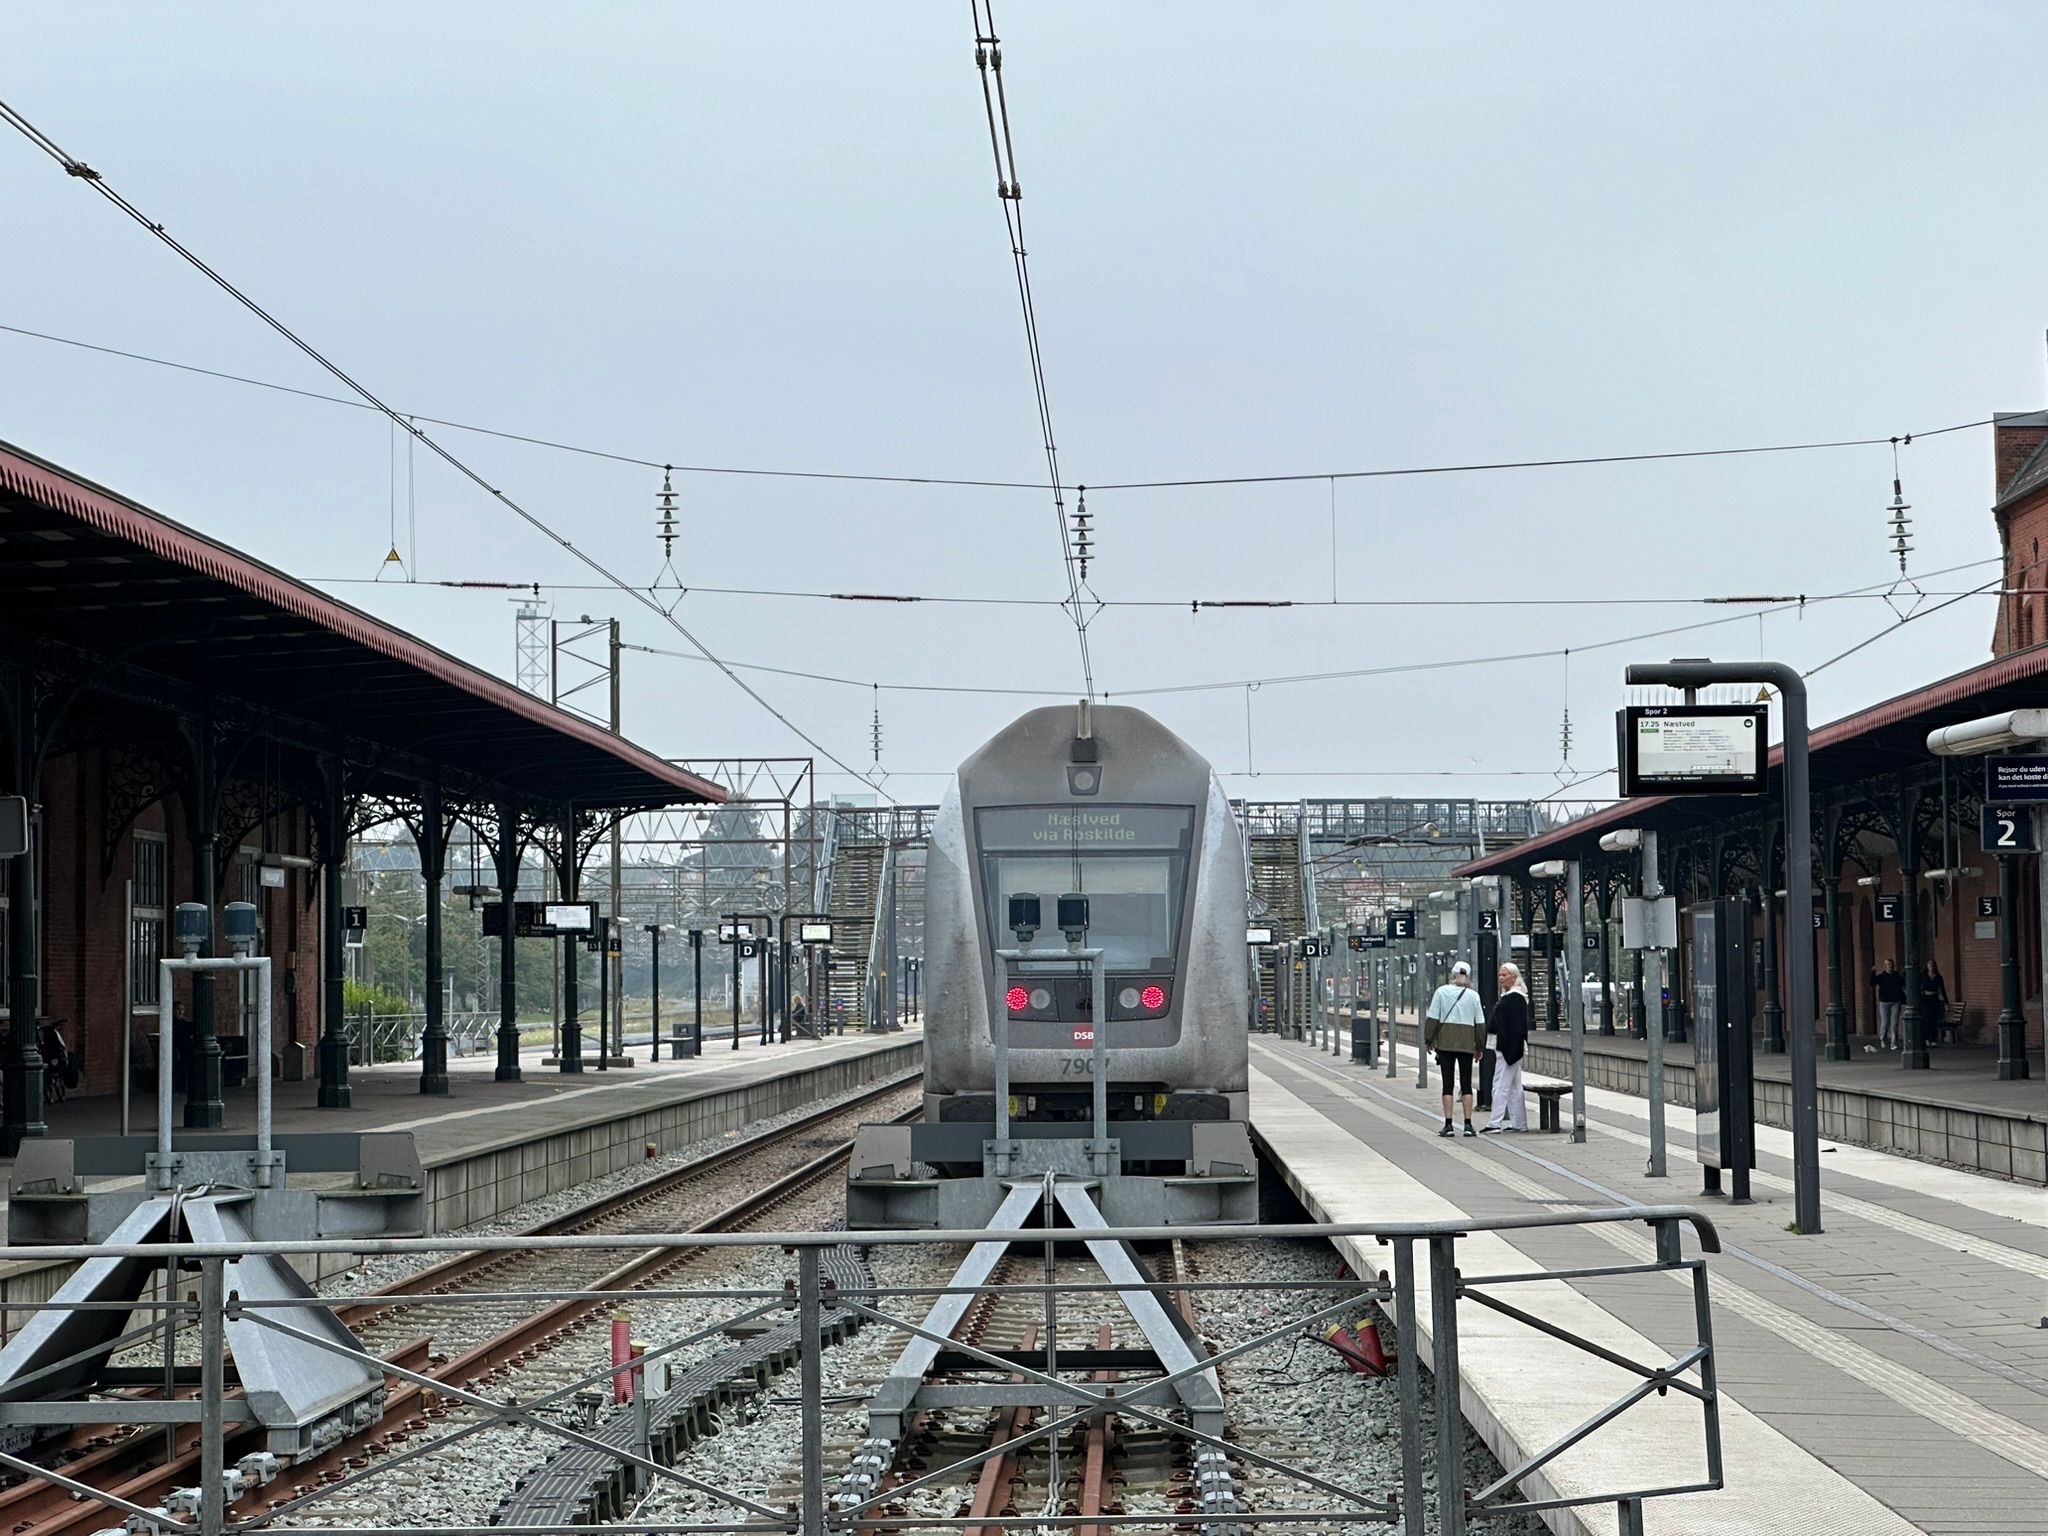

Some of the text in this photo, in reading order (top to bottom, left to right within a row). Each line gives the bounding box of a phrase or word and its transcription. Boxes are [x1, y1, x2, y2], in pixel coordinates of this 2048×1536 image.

[1996, 810, 2016, 818] Spor
[1033, 828, 1136, 840] via Roskilde
[1998, 820, 2016, 846] 2
[1883, 904, 1894, 918] E
[1983, 902, 1992, 914] 3
[352, 913, 361, 926] 1
[1483, 916, 1492, 928] 2
[1814, 917, 1821, 927] 3
[1396, 920, 1407, 935] E
[1587, 938, 1596, 947] D
[743, 946, 753, 956] D
[1306, 945, 1316, 955] D
[1074, 1032, 1095, 1040] DSB
